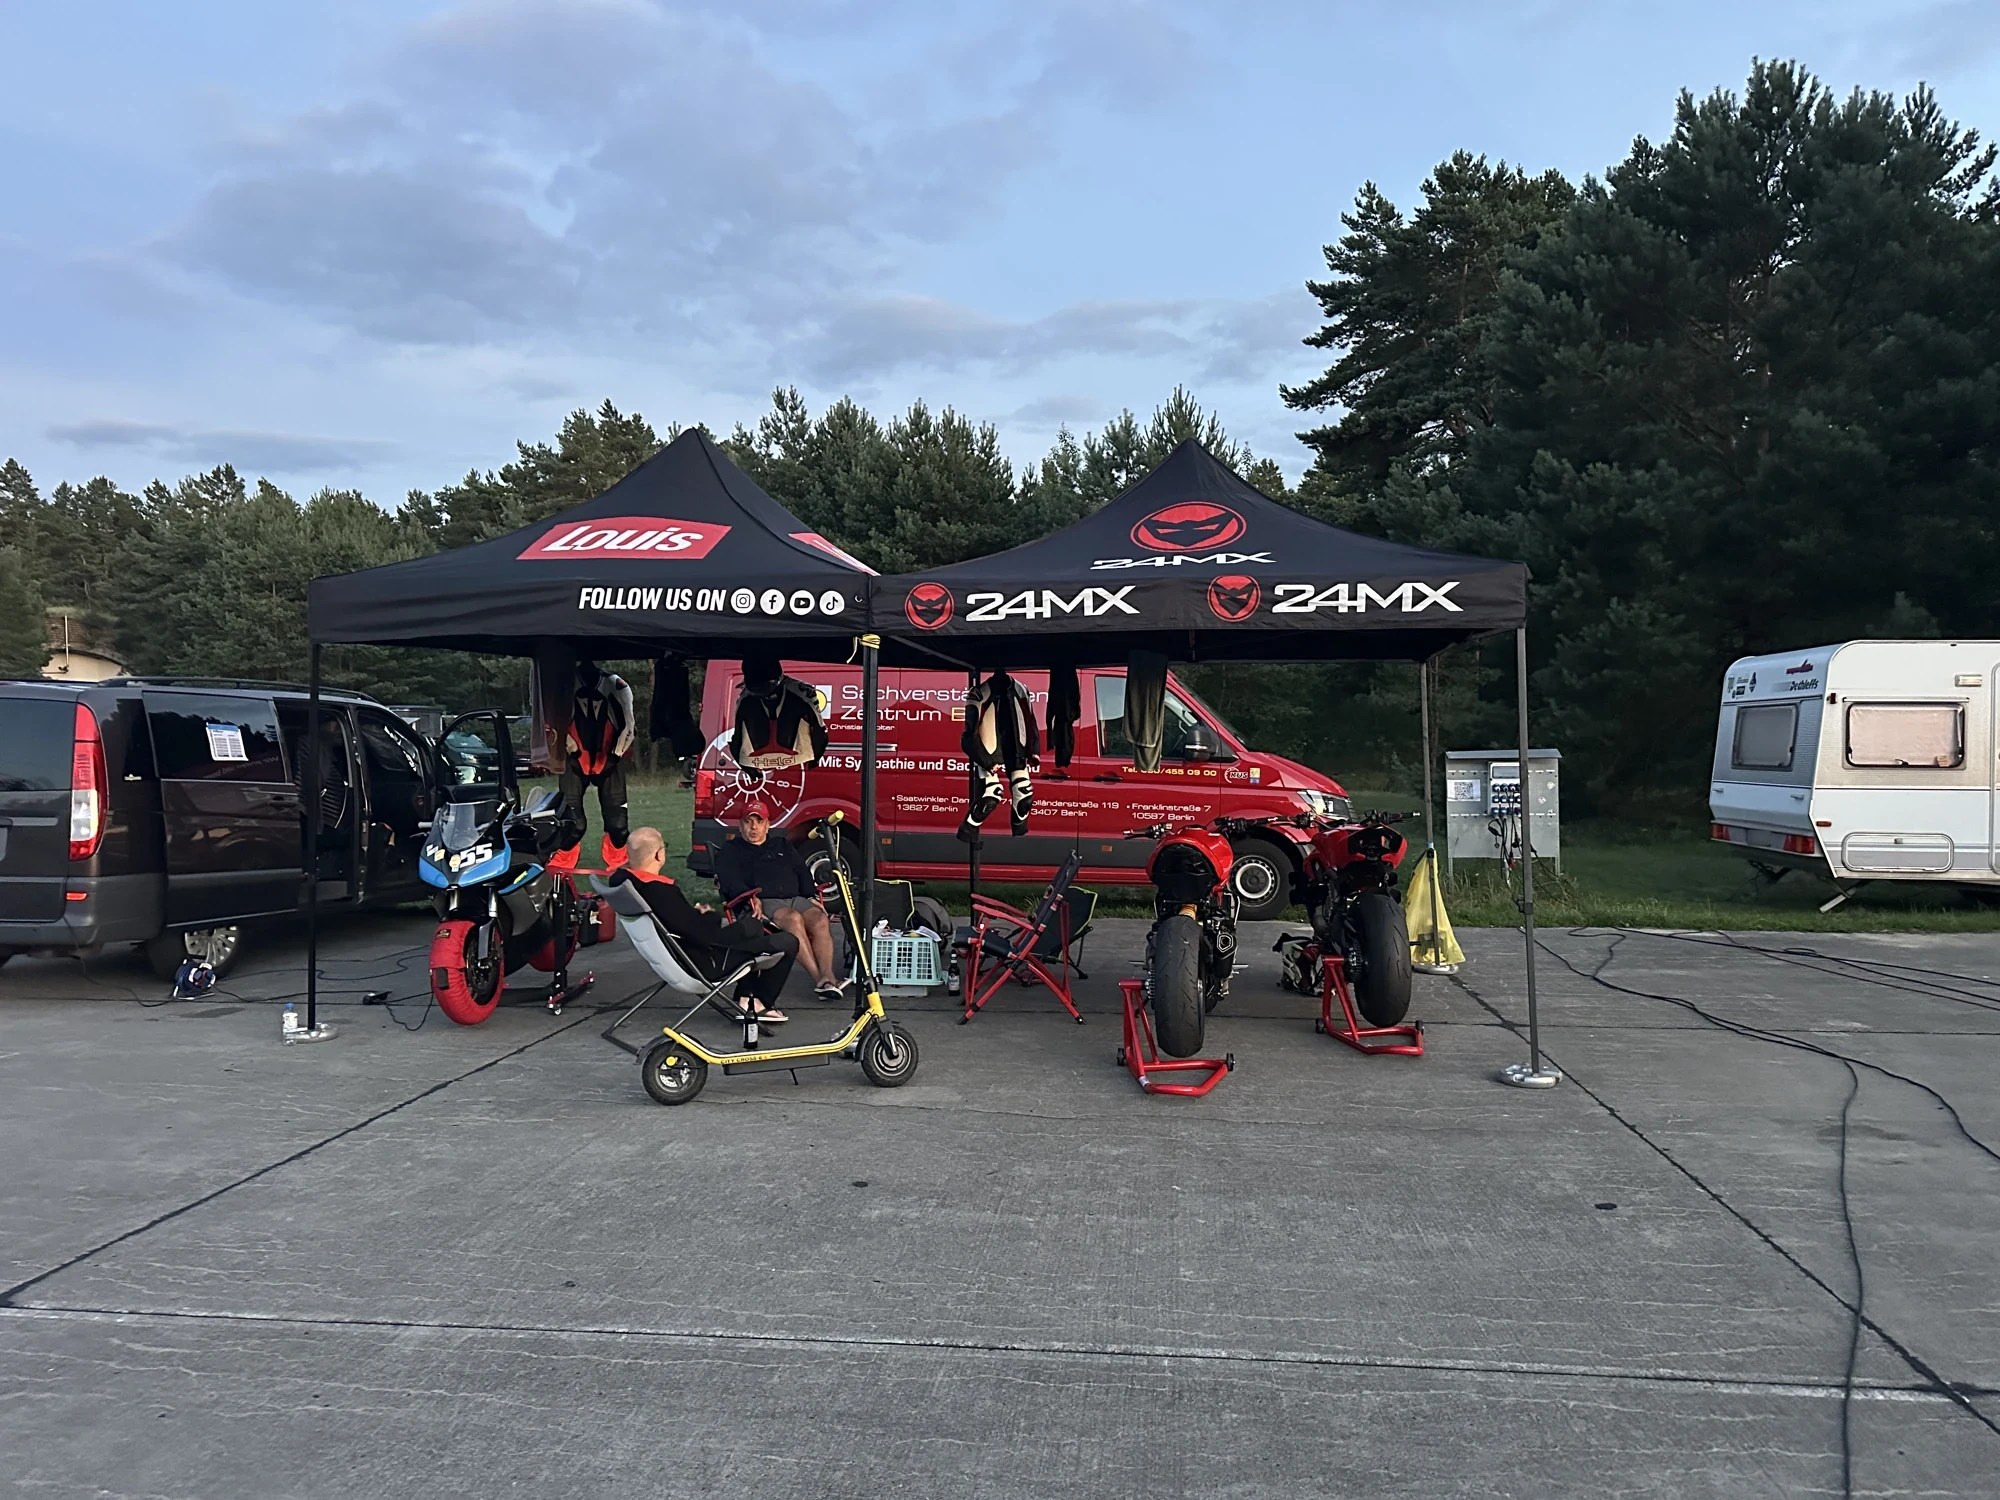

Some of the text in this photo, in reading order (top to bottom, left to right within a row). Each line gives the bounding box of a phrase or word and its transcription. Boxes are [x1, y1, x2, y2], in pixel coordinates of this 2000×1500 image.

[541, 525, 704, 553] Louis
[1090, 551, 1277, 570] 24MX
[578, 587, 727, 612] FOLLOW US ON
[965, 584, 1141, 622] 24MX
[1271, 581, 1464, 613] 24MX
[818, 755, 842, 768] Mit
[845, 756, 915, 771] Sypathie
[918, 758, 943, 771] und
[896, 794, 948, 804] Saatwinkler
[1032, 799, 1120, 810] olländerstraße 119
[1132, 803, 1201, 812] Franklinstraße
[897, 804, 930, 812] 13627
[1132, 812, 1195, 821] 10587 Berlin
[460, 843, 493, 868] 55
